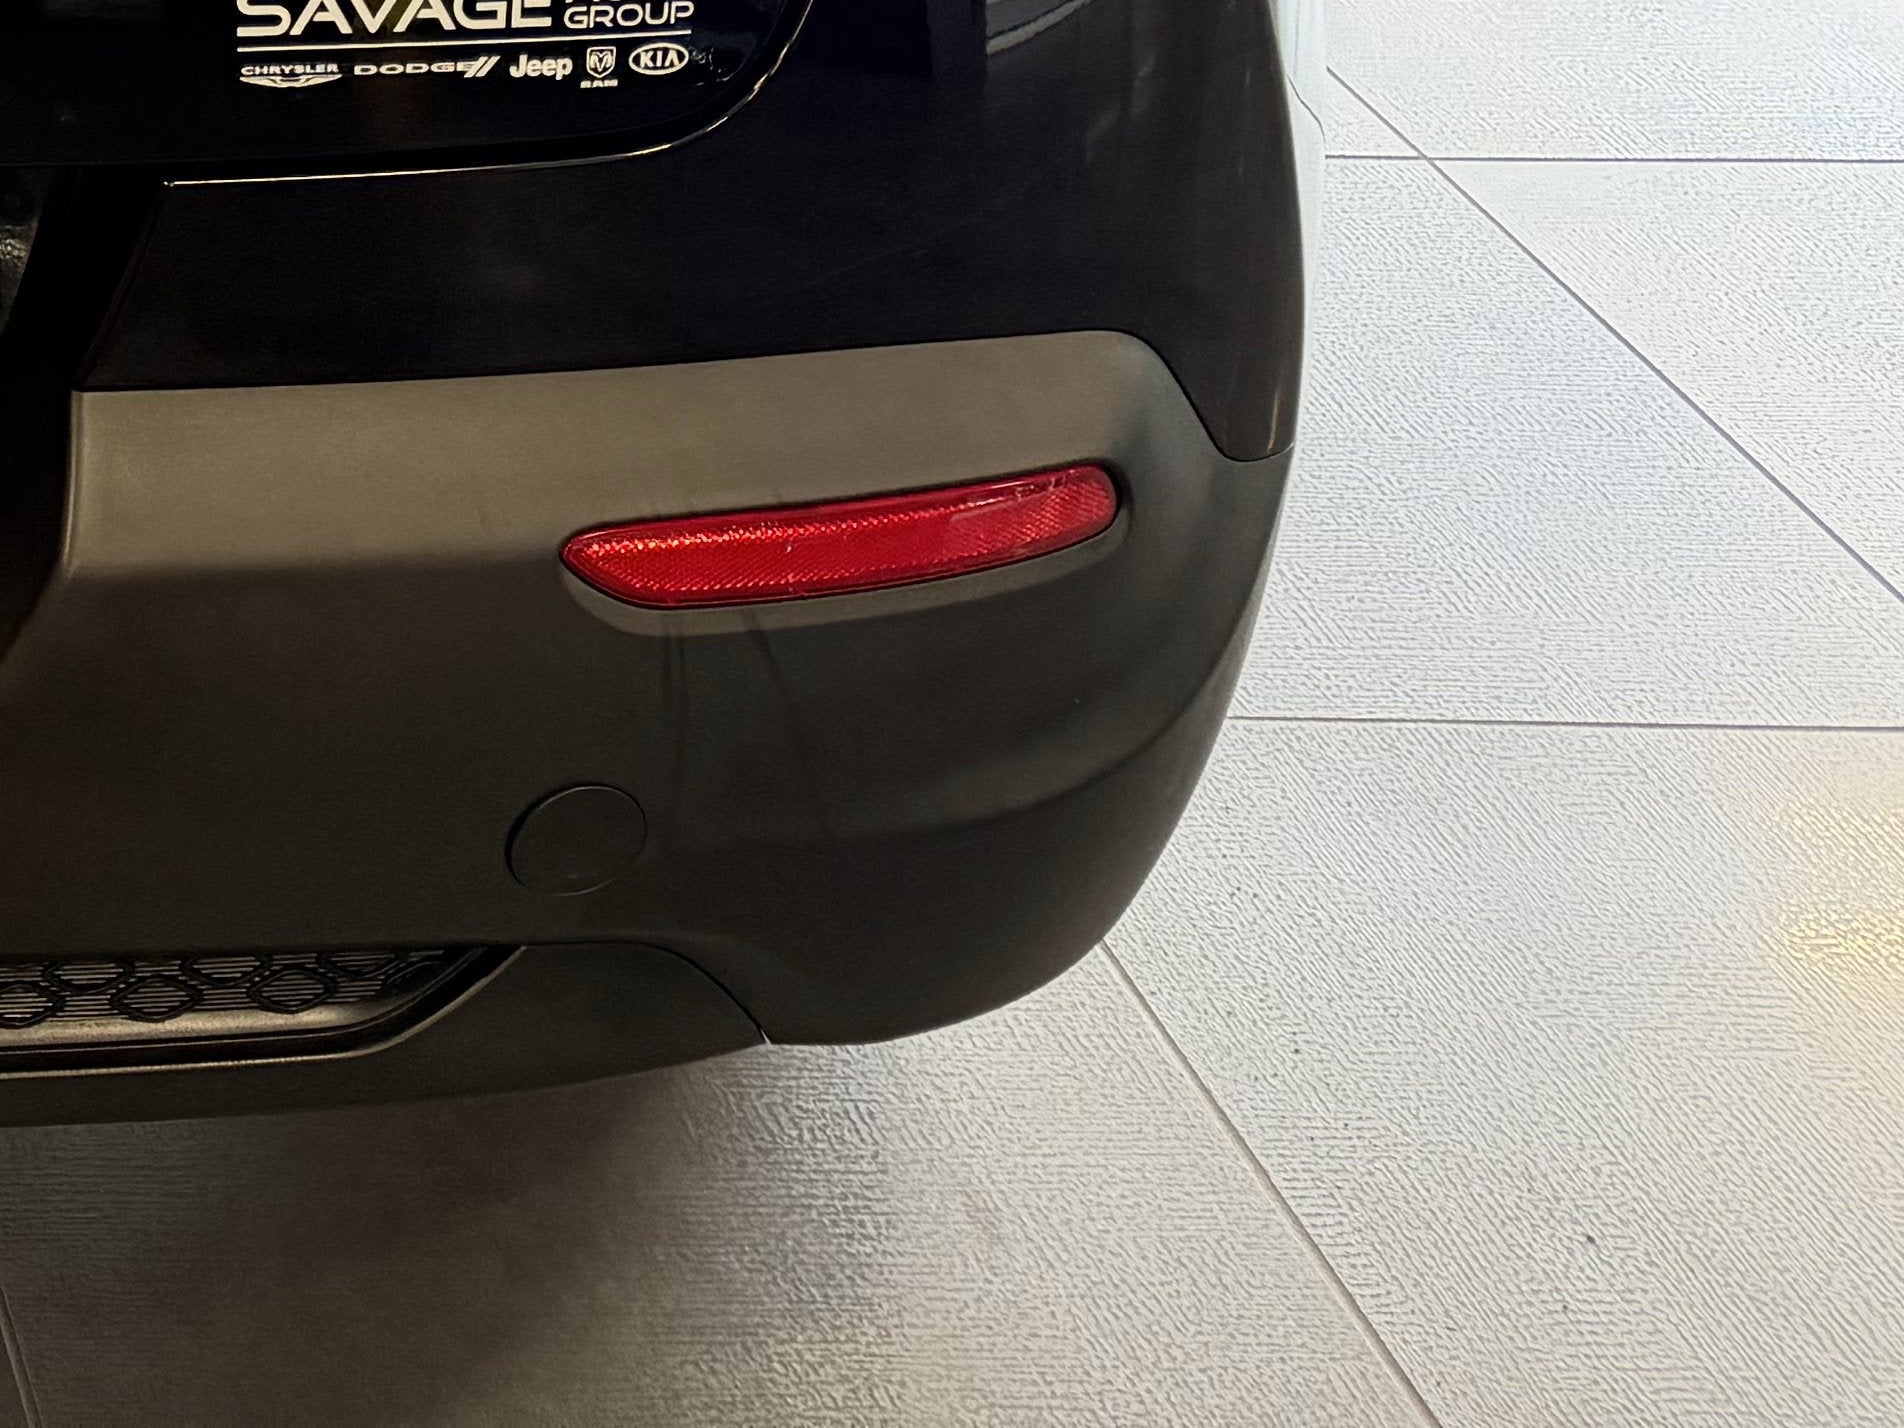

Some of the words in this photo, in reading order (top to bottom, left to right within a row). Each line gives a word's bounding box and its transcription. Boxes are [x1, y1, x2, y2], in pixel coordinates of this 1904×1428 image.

[563, 1, 695, 30] GROUP
[241, 63, 339, 75] CHRYSLER
[353, 61, 477, 76] DODGE
[509, 54, 573, 81] Jeep
[638, 49, 680, 69] KIA
[580, 79, 619, 89] RAM
